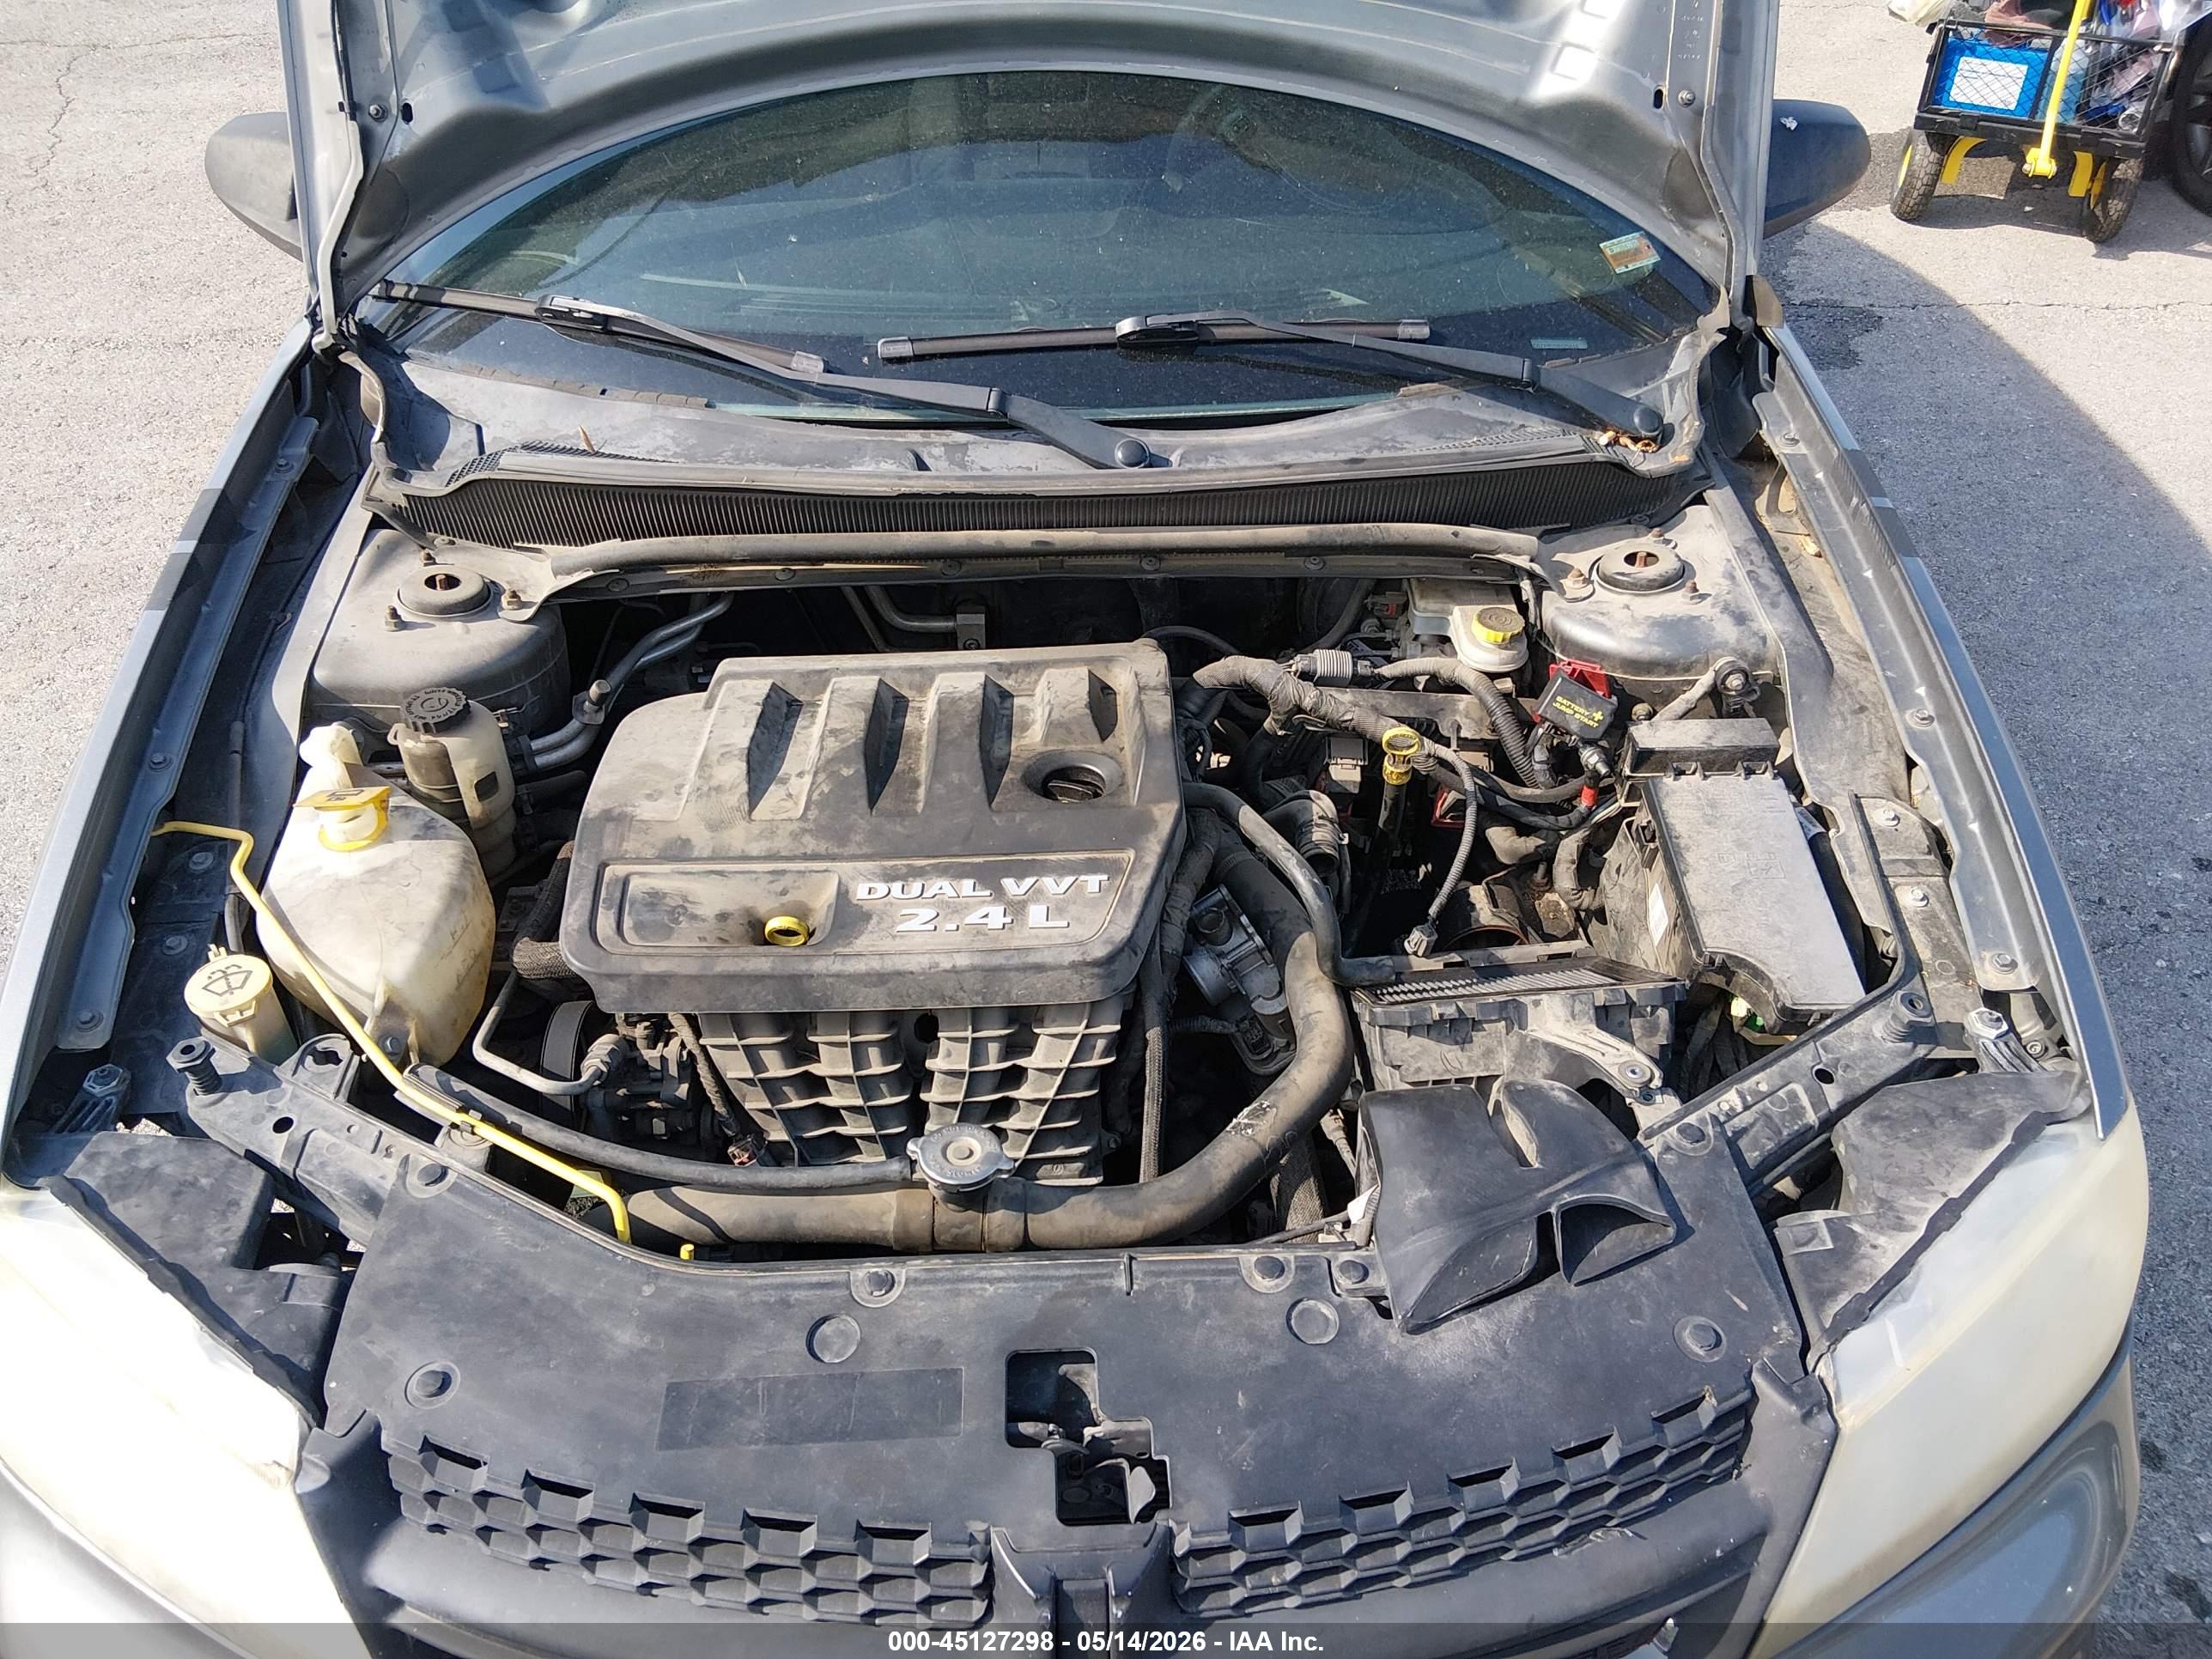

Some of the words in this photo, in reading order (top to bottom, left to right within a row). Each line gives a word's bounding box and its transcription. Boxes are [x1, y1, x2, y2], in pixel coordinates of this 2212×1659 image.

[1553, 702, 1574, 714] JUMP
[1574, 713, 1599, 727] START
[1555, 696, 1590, 716] BATTERY
[856, 878, 993, 900] DUAL
[1000, 875, 1109, 896] VVT
